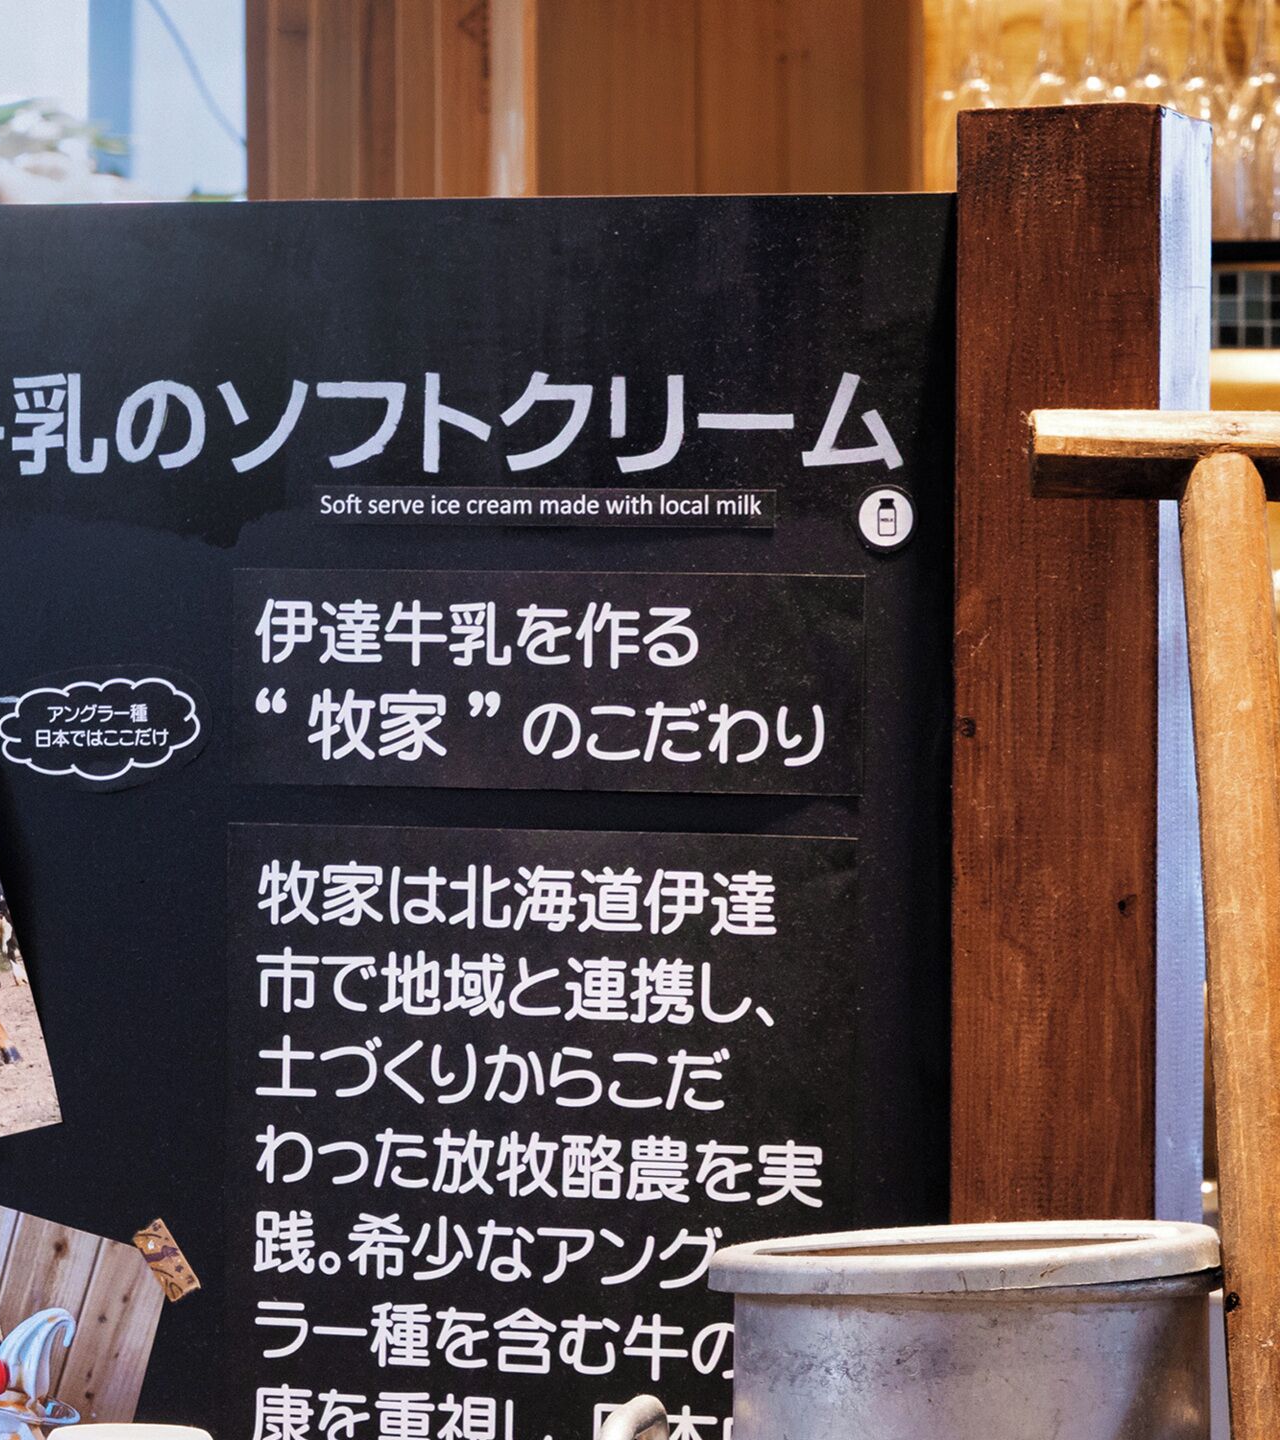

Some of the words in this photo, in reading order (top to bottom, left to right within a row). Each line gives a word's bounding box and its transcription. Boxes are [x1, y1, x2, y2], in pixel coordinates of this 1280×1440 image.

[320, 495, 362, 515] Soft
[368, 500, 424, 515] serve
[431, 496, 460, 515] ice
[466, 501, 533, 516] cream
[540, 496, 600, 516] made
[606, 495, 653, 516] with
[660, 495, 710, 516] local
[717, 495, 762, 516] milk
[255, 599, 700, 670] 伊達牛乳を作る
[35, 728, 169, 748] 日本ではここだけ
[46, 703, 149, 724] アングラー種
[256, 859, 778, 936] 牧家は北海道伊達
[255, 946, 775, 1027] 市で地域と連携し、
[255, 1034, 730, 1111] 土づくりからこだ
[255, 1124, 824, 1208] わった放牧酪農を実
